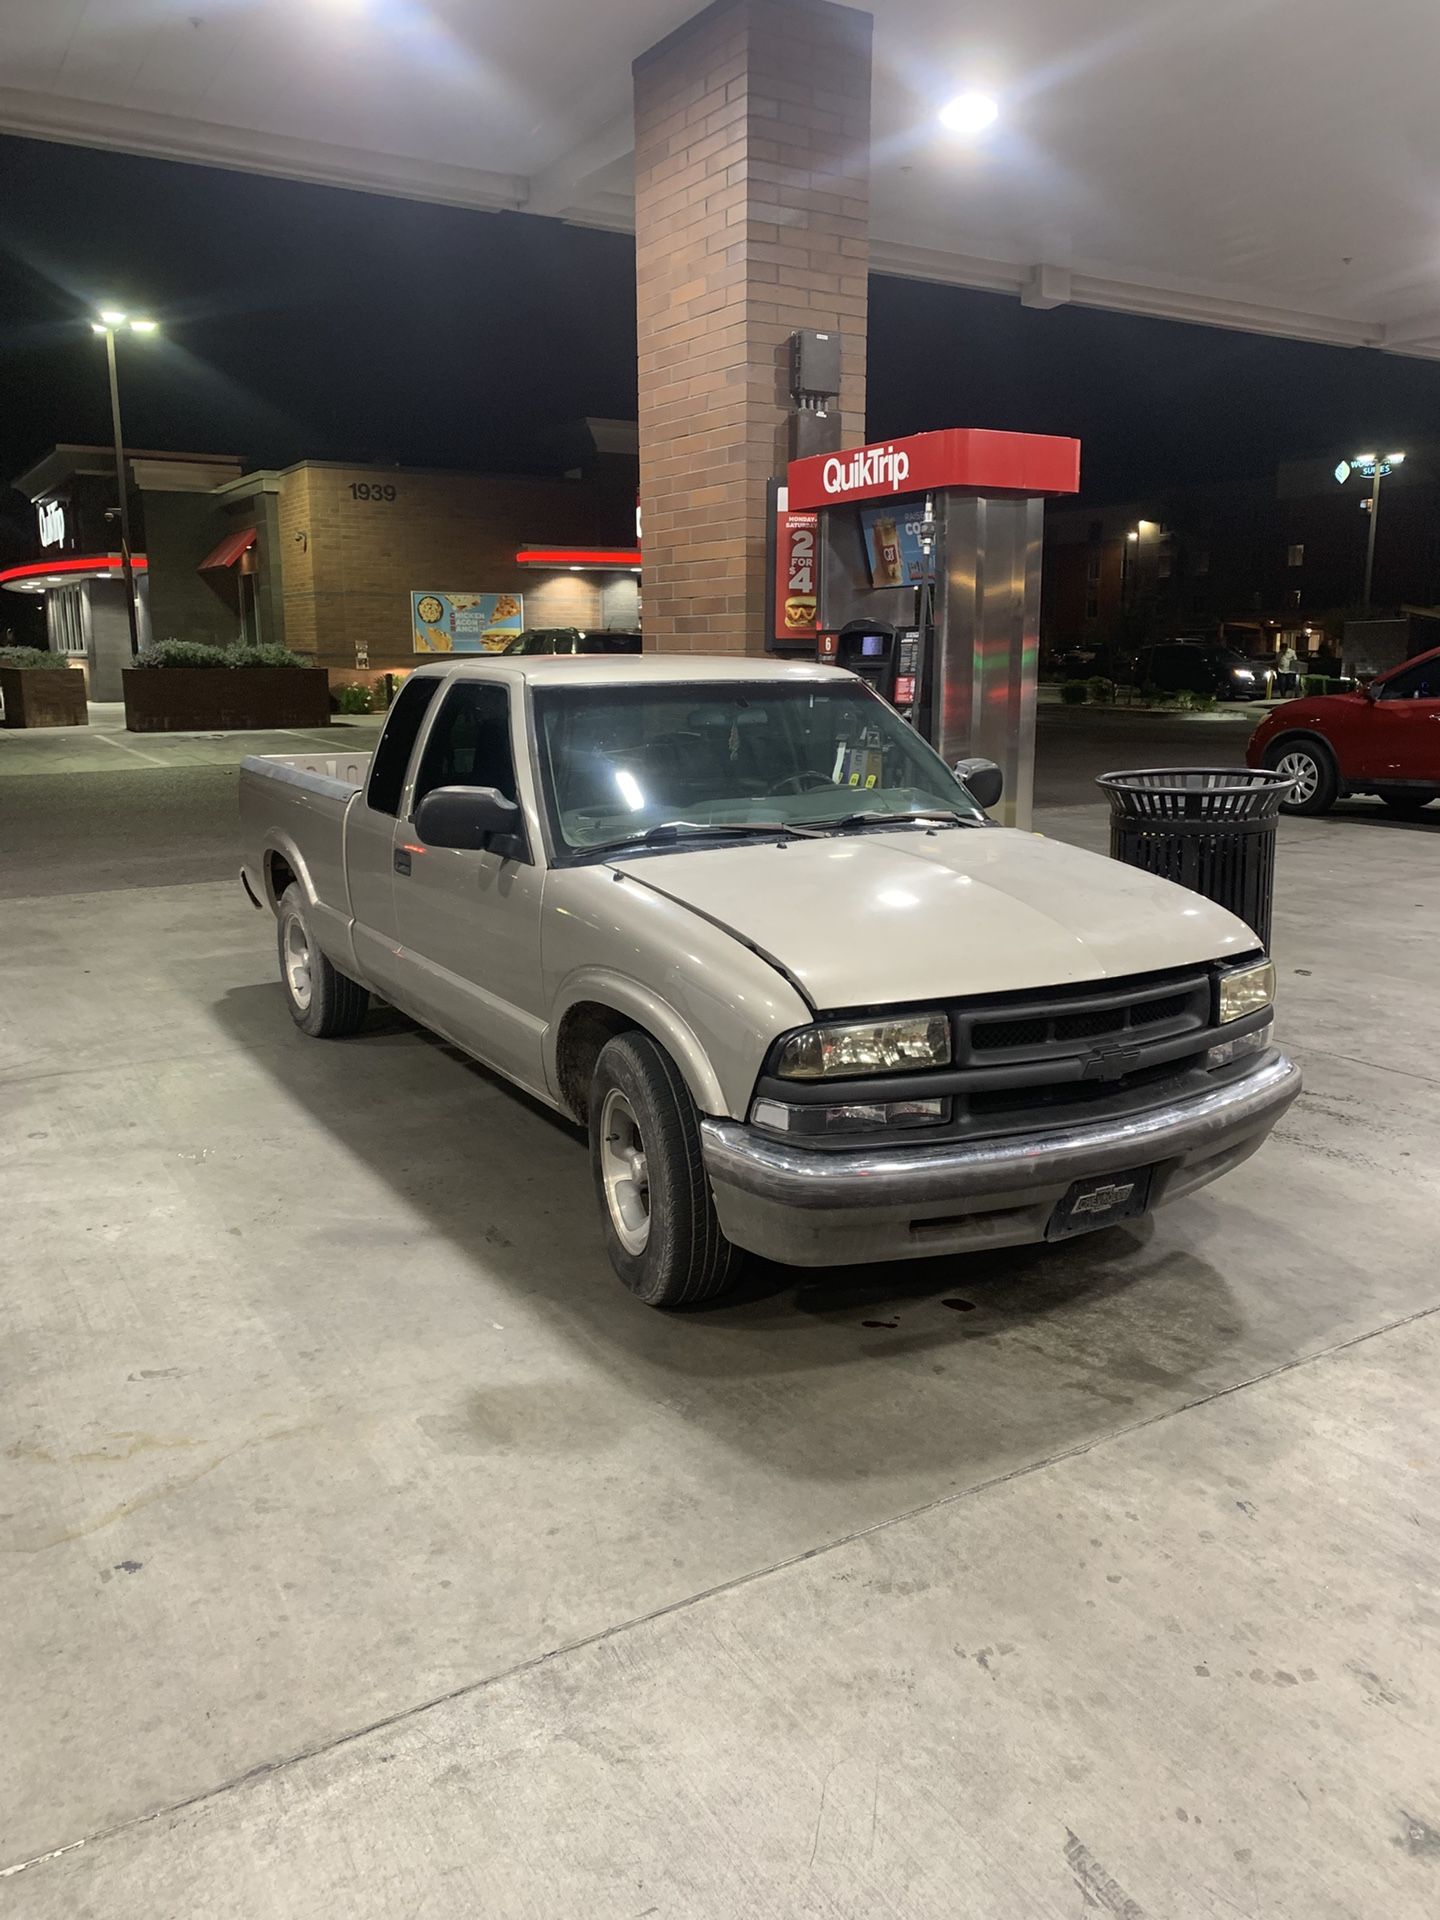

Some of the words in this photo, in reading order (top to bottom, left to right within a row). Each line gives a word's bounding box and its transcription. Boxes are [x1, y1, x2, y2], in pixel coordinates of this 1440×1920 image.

[823, 445, 909, 494] QuikTrip
[348, 483, 396, 501] 1939
[791, 530, 814, 557] 2
[791, 558, 813, 566] FOR
[825, 637, 831, 651] 6
